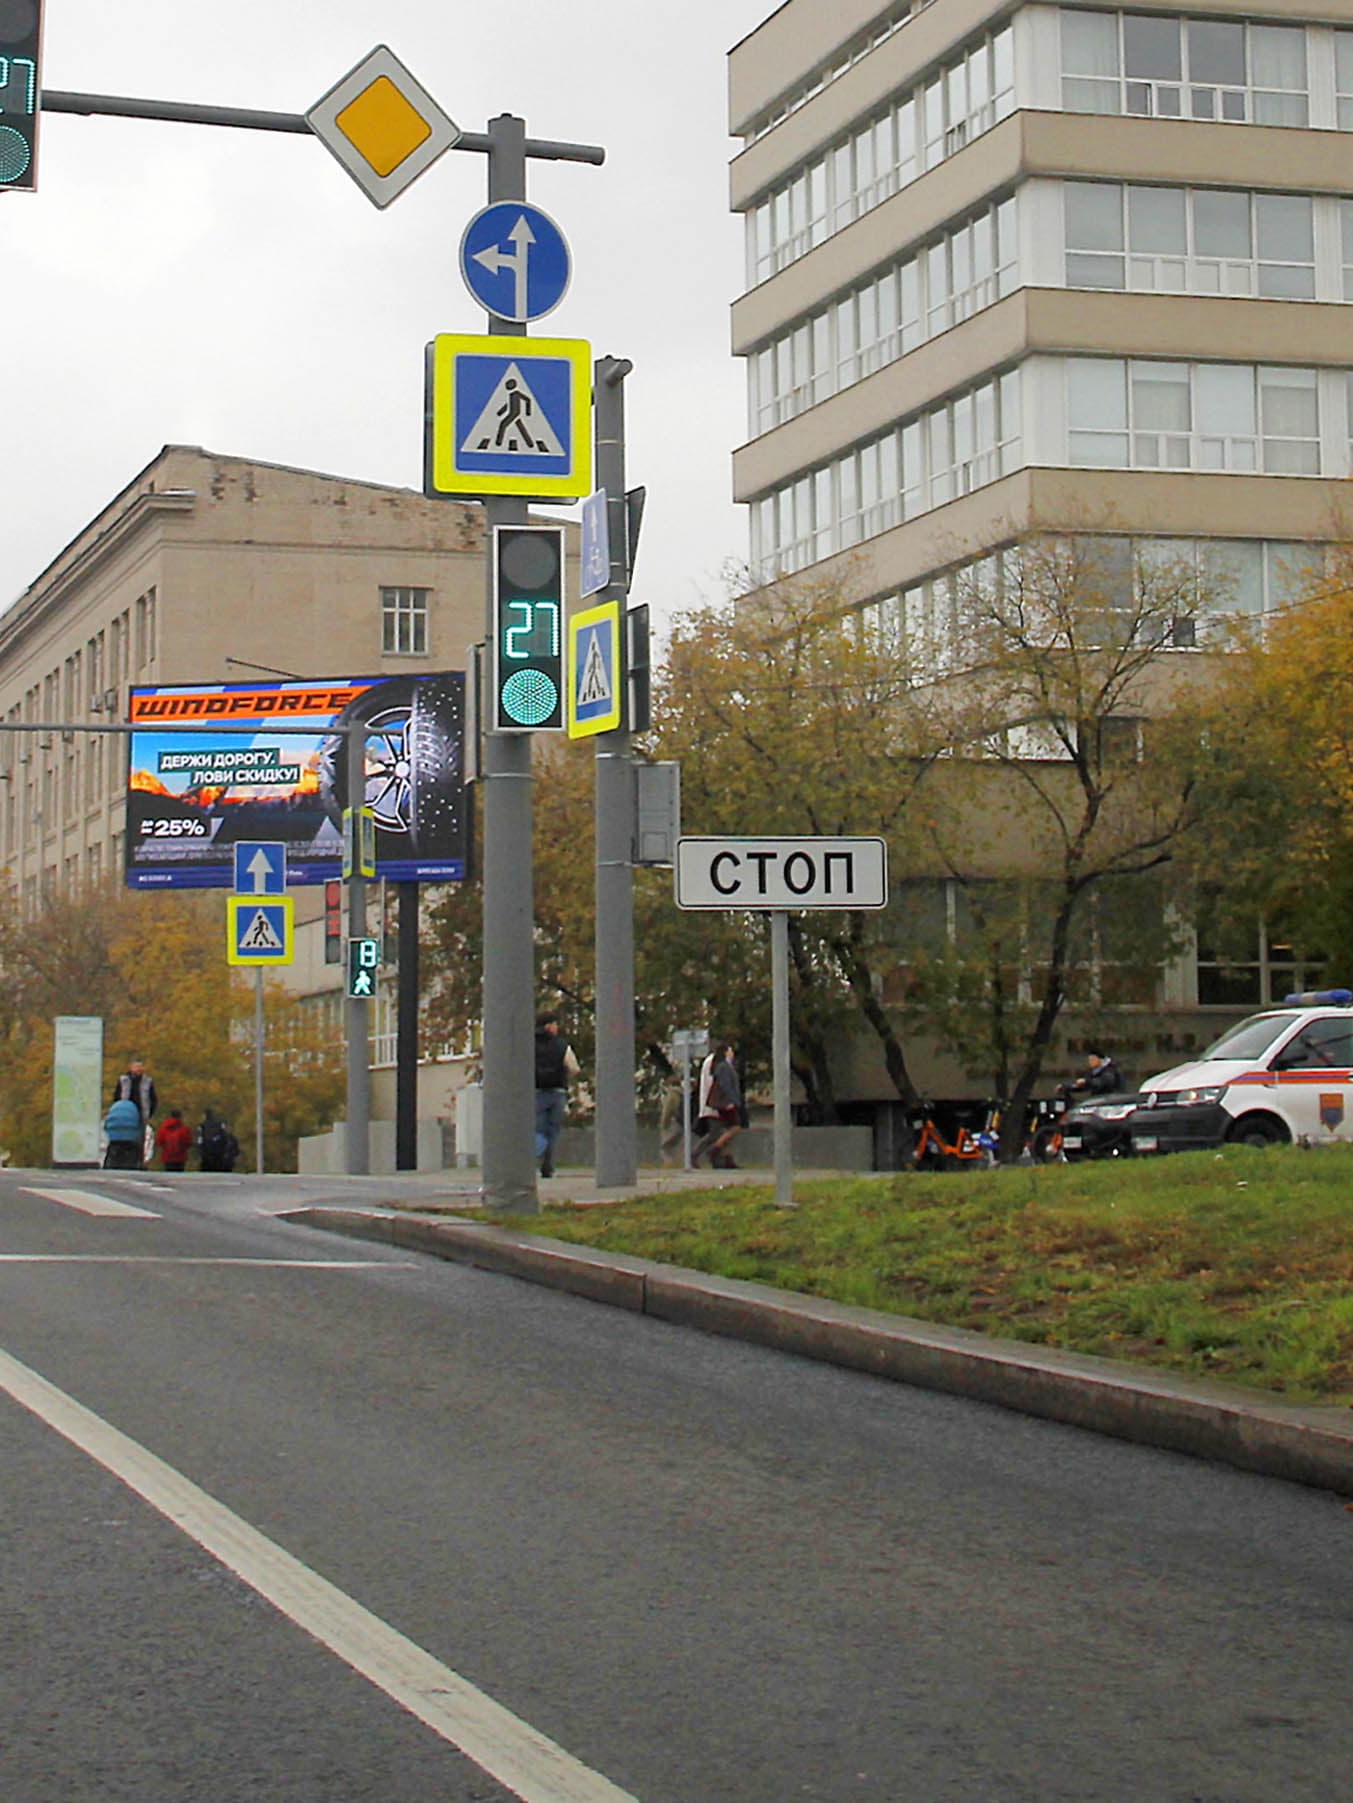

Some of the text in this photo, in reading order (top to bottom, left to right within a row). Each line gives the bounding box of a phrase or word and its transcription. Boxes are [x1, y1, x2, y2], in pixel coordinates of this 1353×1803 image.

[505, 602, 558, 659] 27
[135, 692, 353, 716] WINDFORCE
[160, 755, 211, 770] ДЕРЖИ
[193, 767, 298, 785] ЛОВИ СКИДКУ!
[709, 851, 854, 895] СТОП
